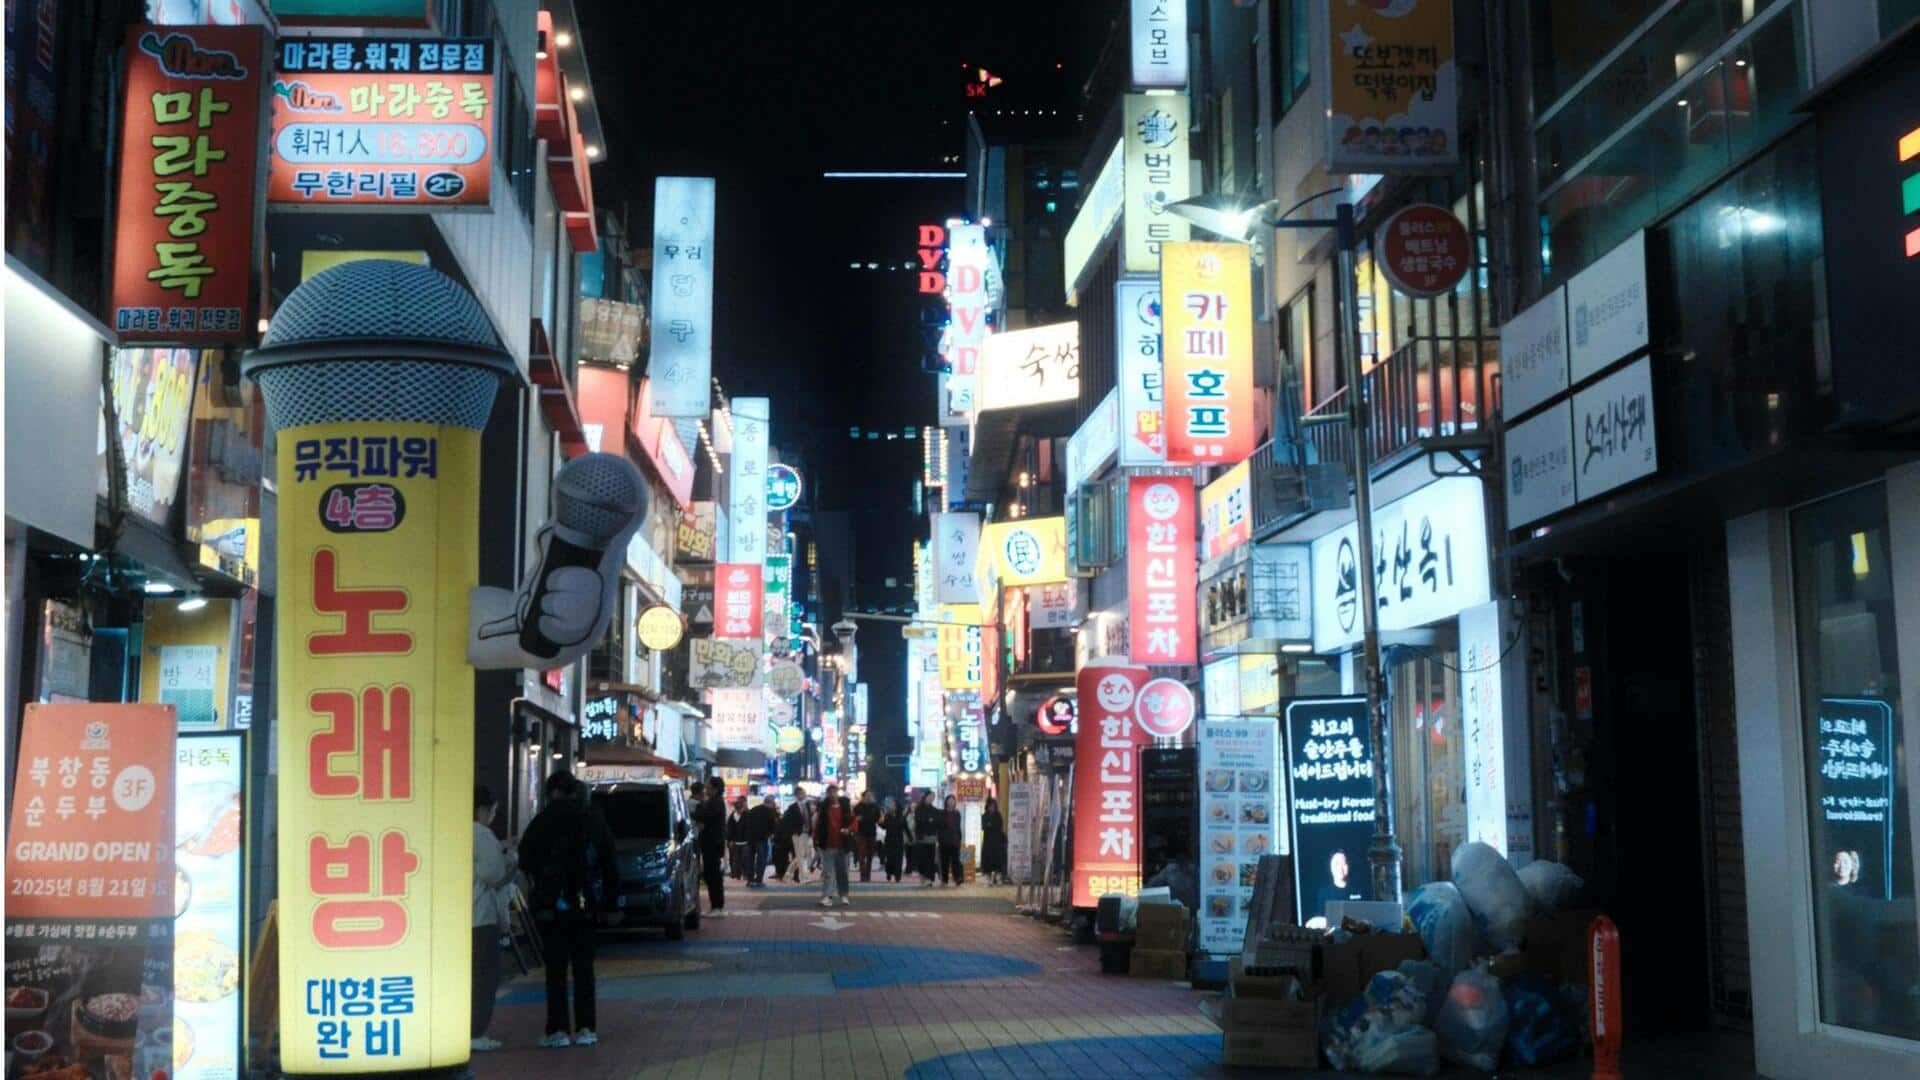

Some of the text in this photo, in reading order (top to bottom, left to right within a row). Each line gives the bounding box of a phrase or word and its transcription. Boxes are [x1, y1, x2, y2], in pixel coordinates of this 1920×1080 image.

[419, 42, 485, 71] 전문점
[350, 82, 489, 119] 마라중독
[965, 84, 987, 97] SK
[147, 87, 230, 297] 마라중독
[292, 171, 419, 199] 무한리필
[428, 175, 463, 194] 2F
[664, 245, 701, 260] 우림
[956, 265, 980, 375] DVD
[295, 435, 438, 483] 뮤직파워
[326, 484, 397, 530] 4층
[1145, 522, 1180, 659] 한신포차
[307, 549, 421, 950] 노래방
[28, 756, 111, 790] 북창동
[121, 779, 147, 798] 3F
[1099, 715, 1135, 861] 한신포차
[24, 796, 107, 827] 순두부
[1295, 797, 1340, 810] Must-try
[1300, 811, 1351, 824] traditional
[15, 841, 150, 862] GRAND OPEN
[11, 878, 73, 897] 2025년
[76, 878, 105, 897] 8월
[109, 878, 147, 896] 21일
[306, 975, 415, 1018] 대형룸
[316, 1018, 402, 1060] 완비
